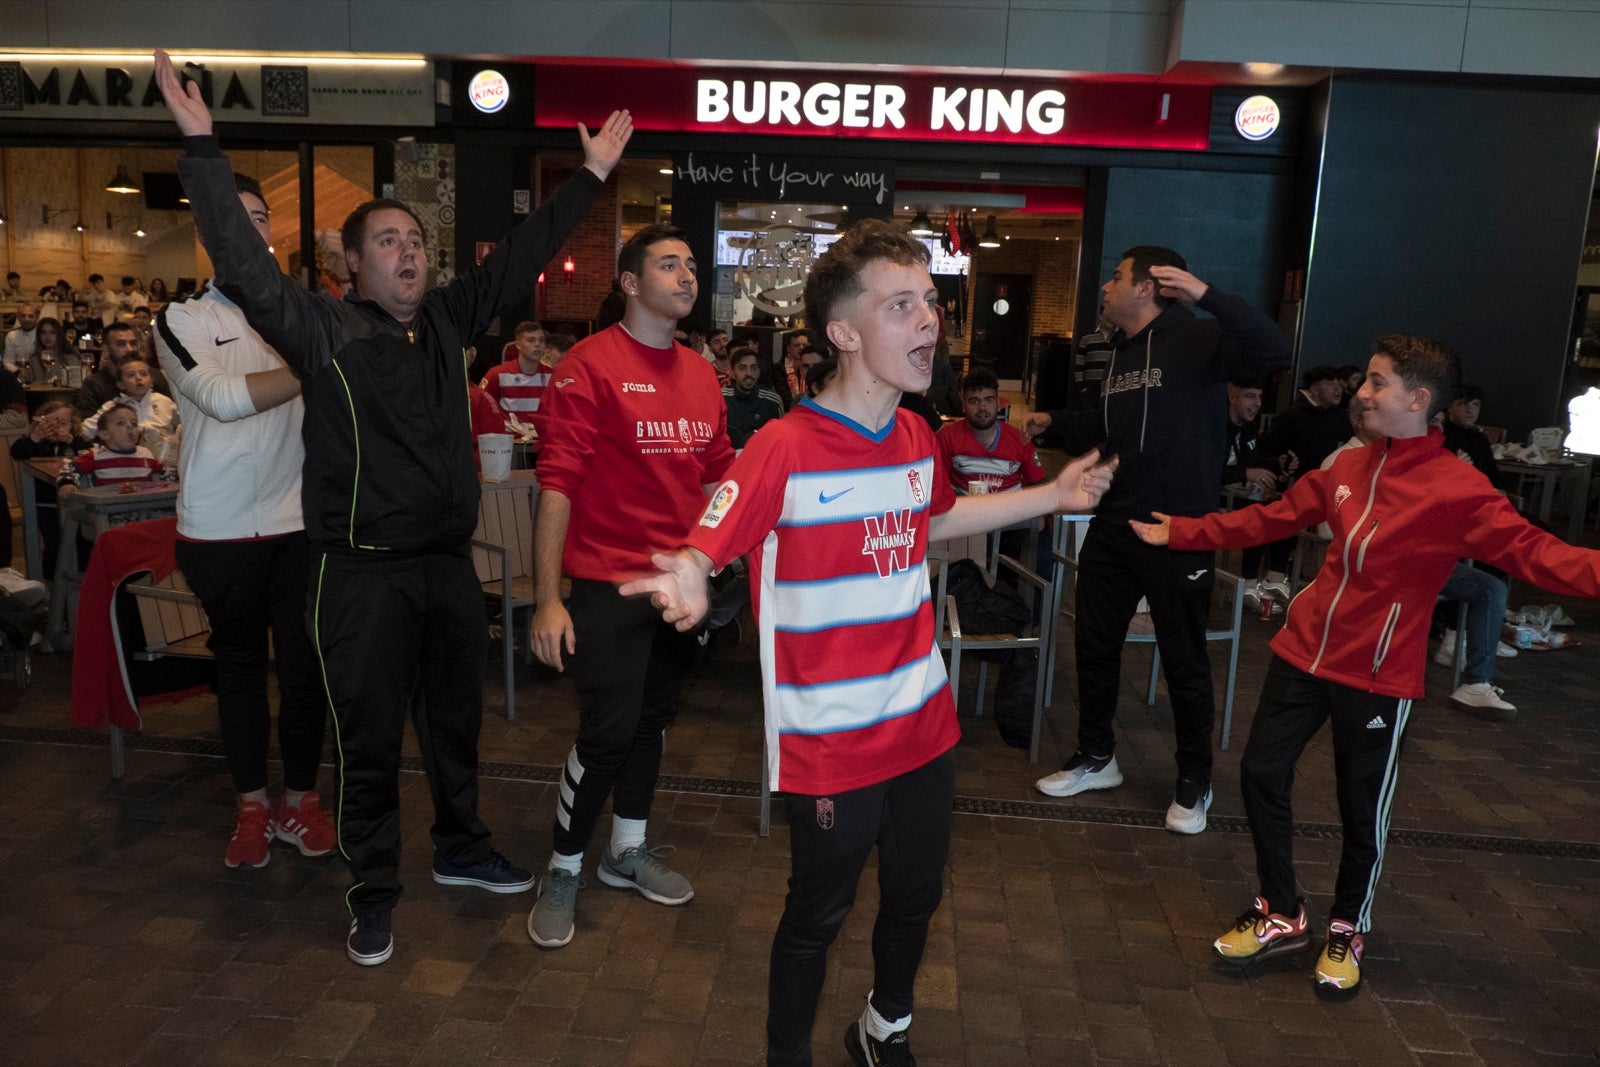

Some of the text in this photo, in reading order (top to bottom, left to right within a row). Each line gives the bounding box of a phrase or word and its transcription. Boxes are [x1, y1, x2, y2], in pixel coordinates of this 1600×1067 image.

[475, 86, 503, 100] KING
[696, 79, 1066, 134] BURGER KING
[1242, 113, 1275, 127] KING
[678, 152, 733, 184] Have
[743, 153, 760, 187] it
[843, 172, 888, 204] way
[692, 421, 713, 438] 1931
[869, 532, 910, 550] WINAMAX
